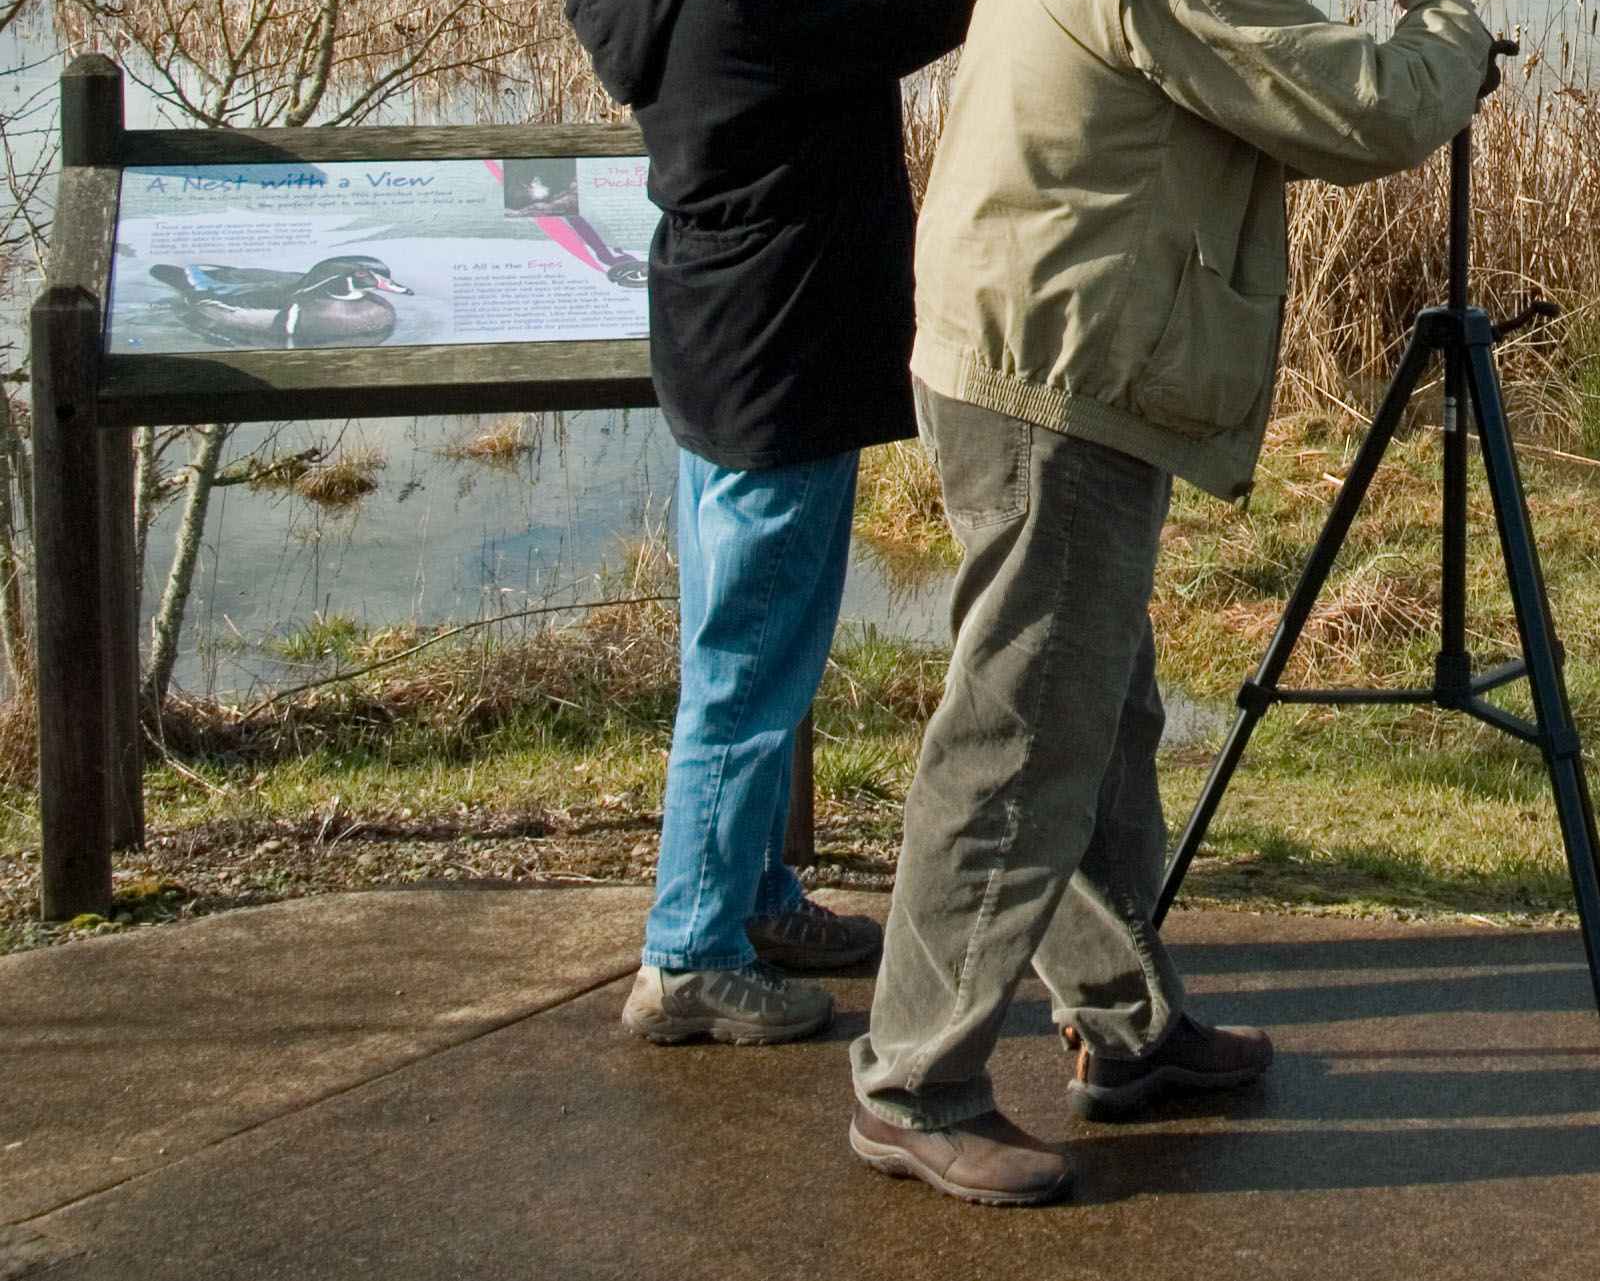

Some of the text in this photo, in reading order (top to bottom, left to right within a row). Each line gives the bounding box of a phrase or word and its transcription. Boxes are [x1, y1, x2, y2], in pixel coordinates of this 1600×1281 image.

[147, 176, 168, 193] A
[182, 174, 248, 193] Nest
[260, 172, 327, 190] with
[338, 177, 351, 189] a
[366, 171, 435, 187] View
